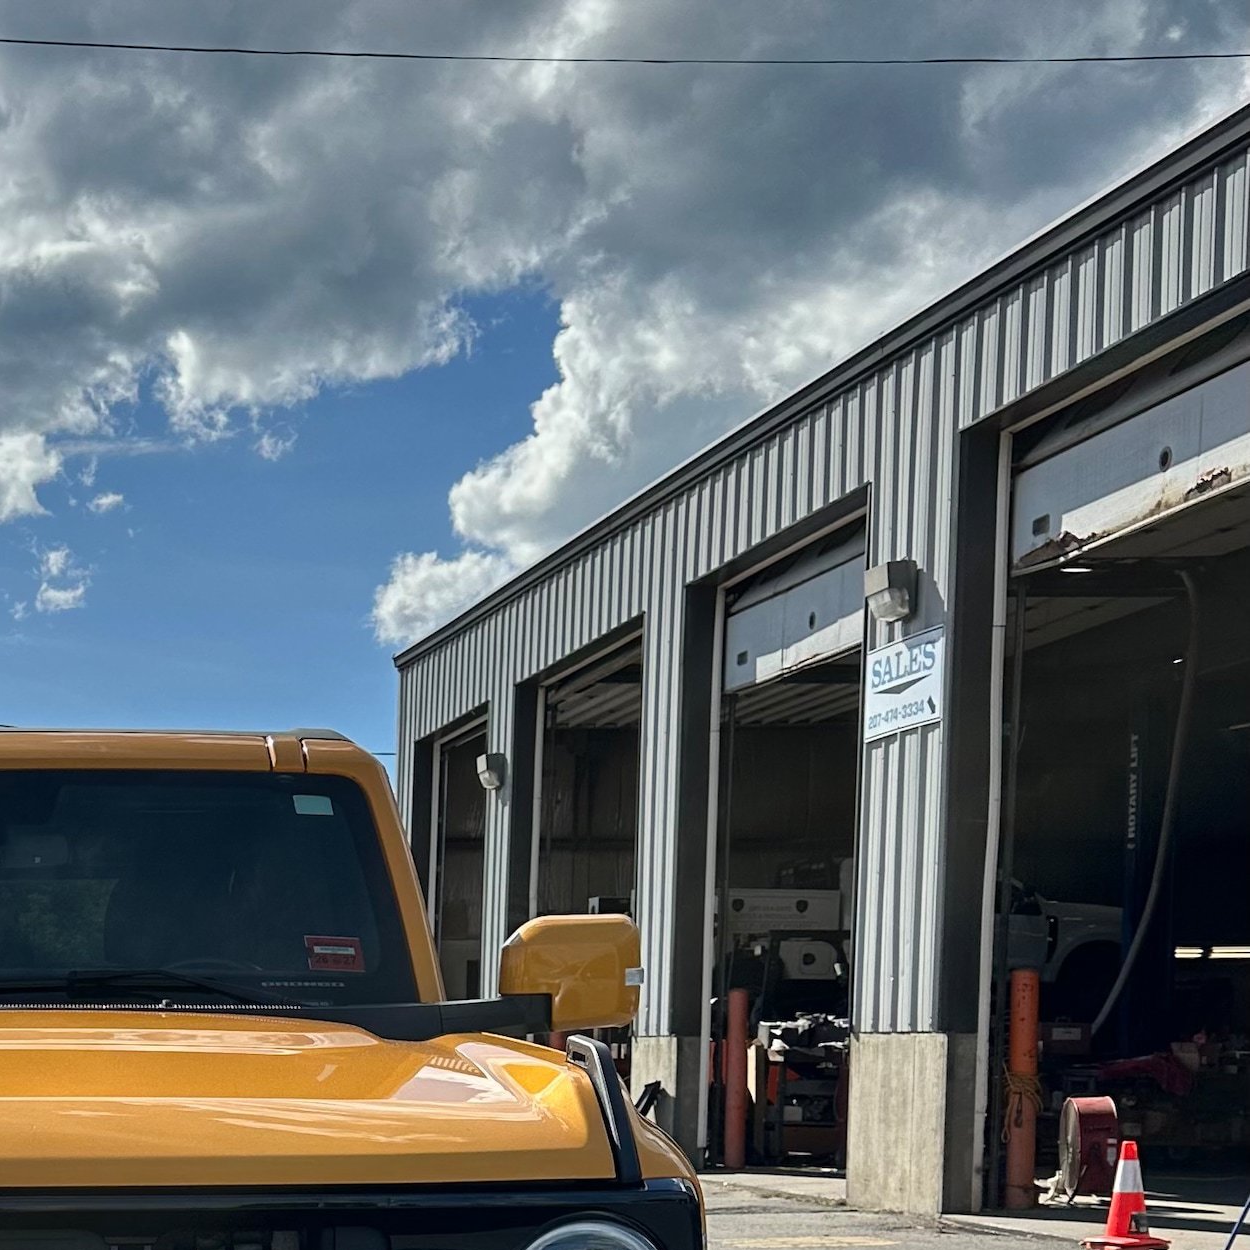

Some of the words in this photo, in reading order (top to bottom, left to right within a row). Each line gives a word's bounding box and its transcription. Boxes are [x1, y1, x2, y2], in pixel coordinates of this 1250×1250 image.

[871, 640, 936, 689] SALES
[868, 699, 925, 730] 207-474-3334
[1130, 733, 1138, 767] LIFT
[1128, 773, 1137, 838] ROTARY
